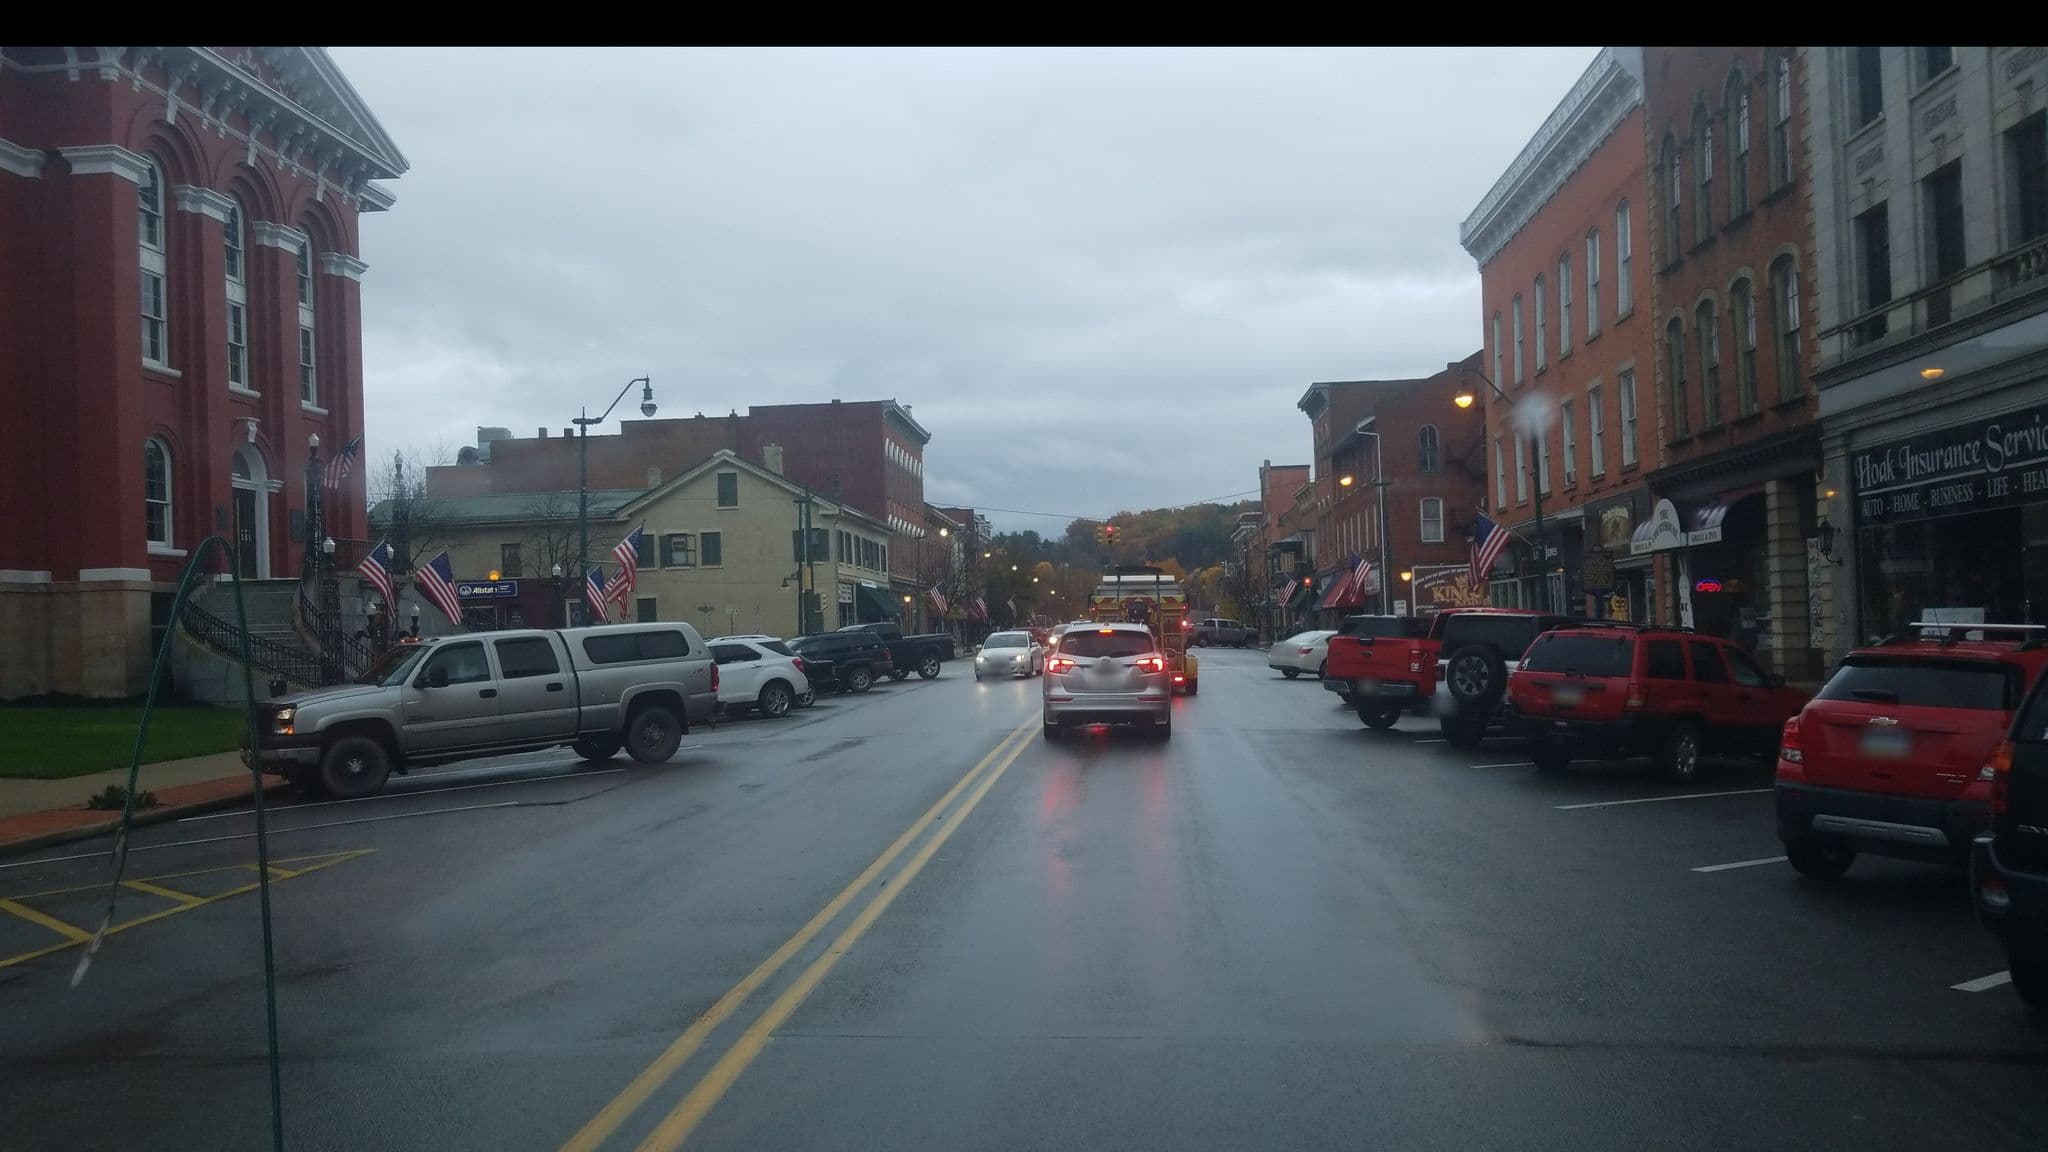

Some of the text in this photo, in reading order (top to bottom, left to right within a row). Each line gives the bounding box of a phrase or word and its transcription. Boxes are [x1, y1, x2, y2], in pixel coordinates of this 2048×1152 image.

[1855, 449, 1896, 489] Hoak
[1898, 439, 1981, 480] Insurance
[1862, 498, 1884, 517] AUTO
[1893, 492, 1920, 513] HOME
[1930, 482, 1974, 507] BUSINESS
[1987, 476, 2010, 498] LIFE
[1696, 582, 1722, 592] OPEN
